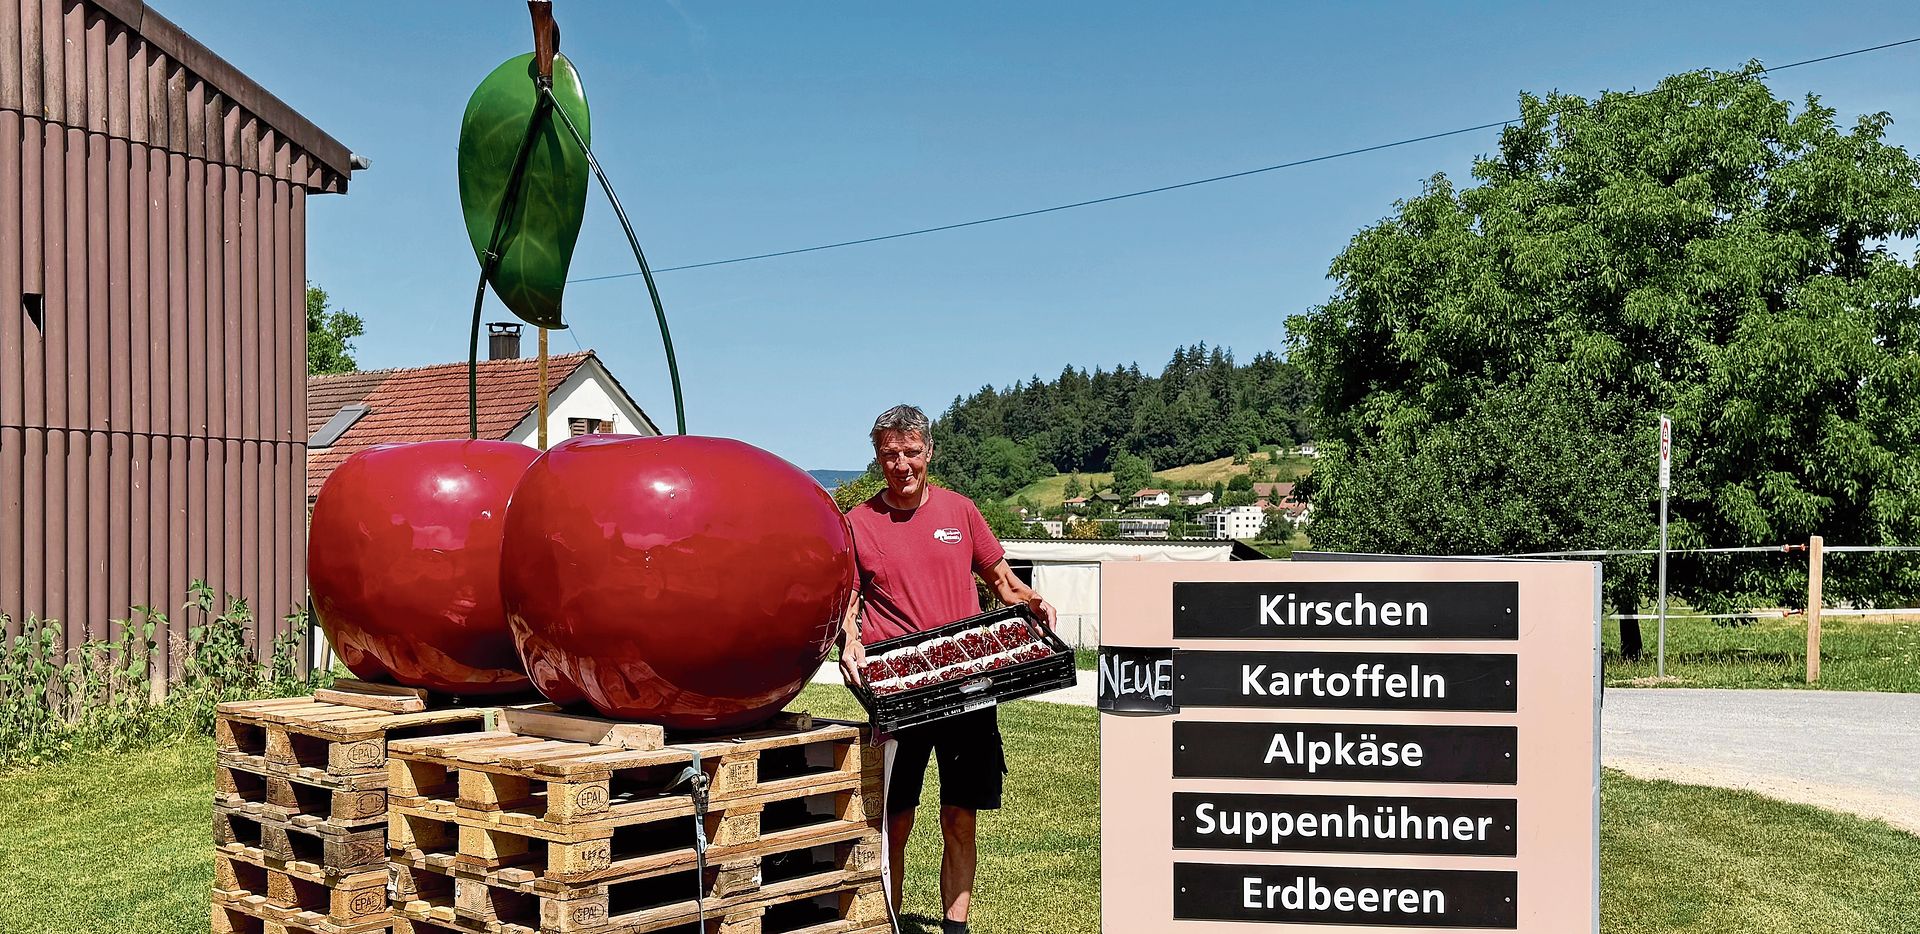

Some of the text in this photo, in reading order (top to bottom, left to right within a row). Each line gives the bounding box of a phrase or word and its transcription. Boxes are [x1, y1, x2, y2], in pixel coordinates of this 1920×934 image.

[1260, 592, 1428, 626] Kirschen
[1099, 653, 1173, 700] NEUE
[1242, 663, 1445, 698] Kartoffeln
[352, 748, 375, 760] EPAL
[1263, 731, 1423, 773] Alpkäse
[581, 791, 604, 807] EPAL
[1195, 802, 1493, 845] Suppenhühner
[1243, 876, 1446, 914] Erdbeeren
